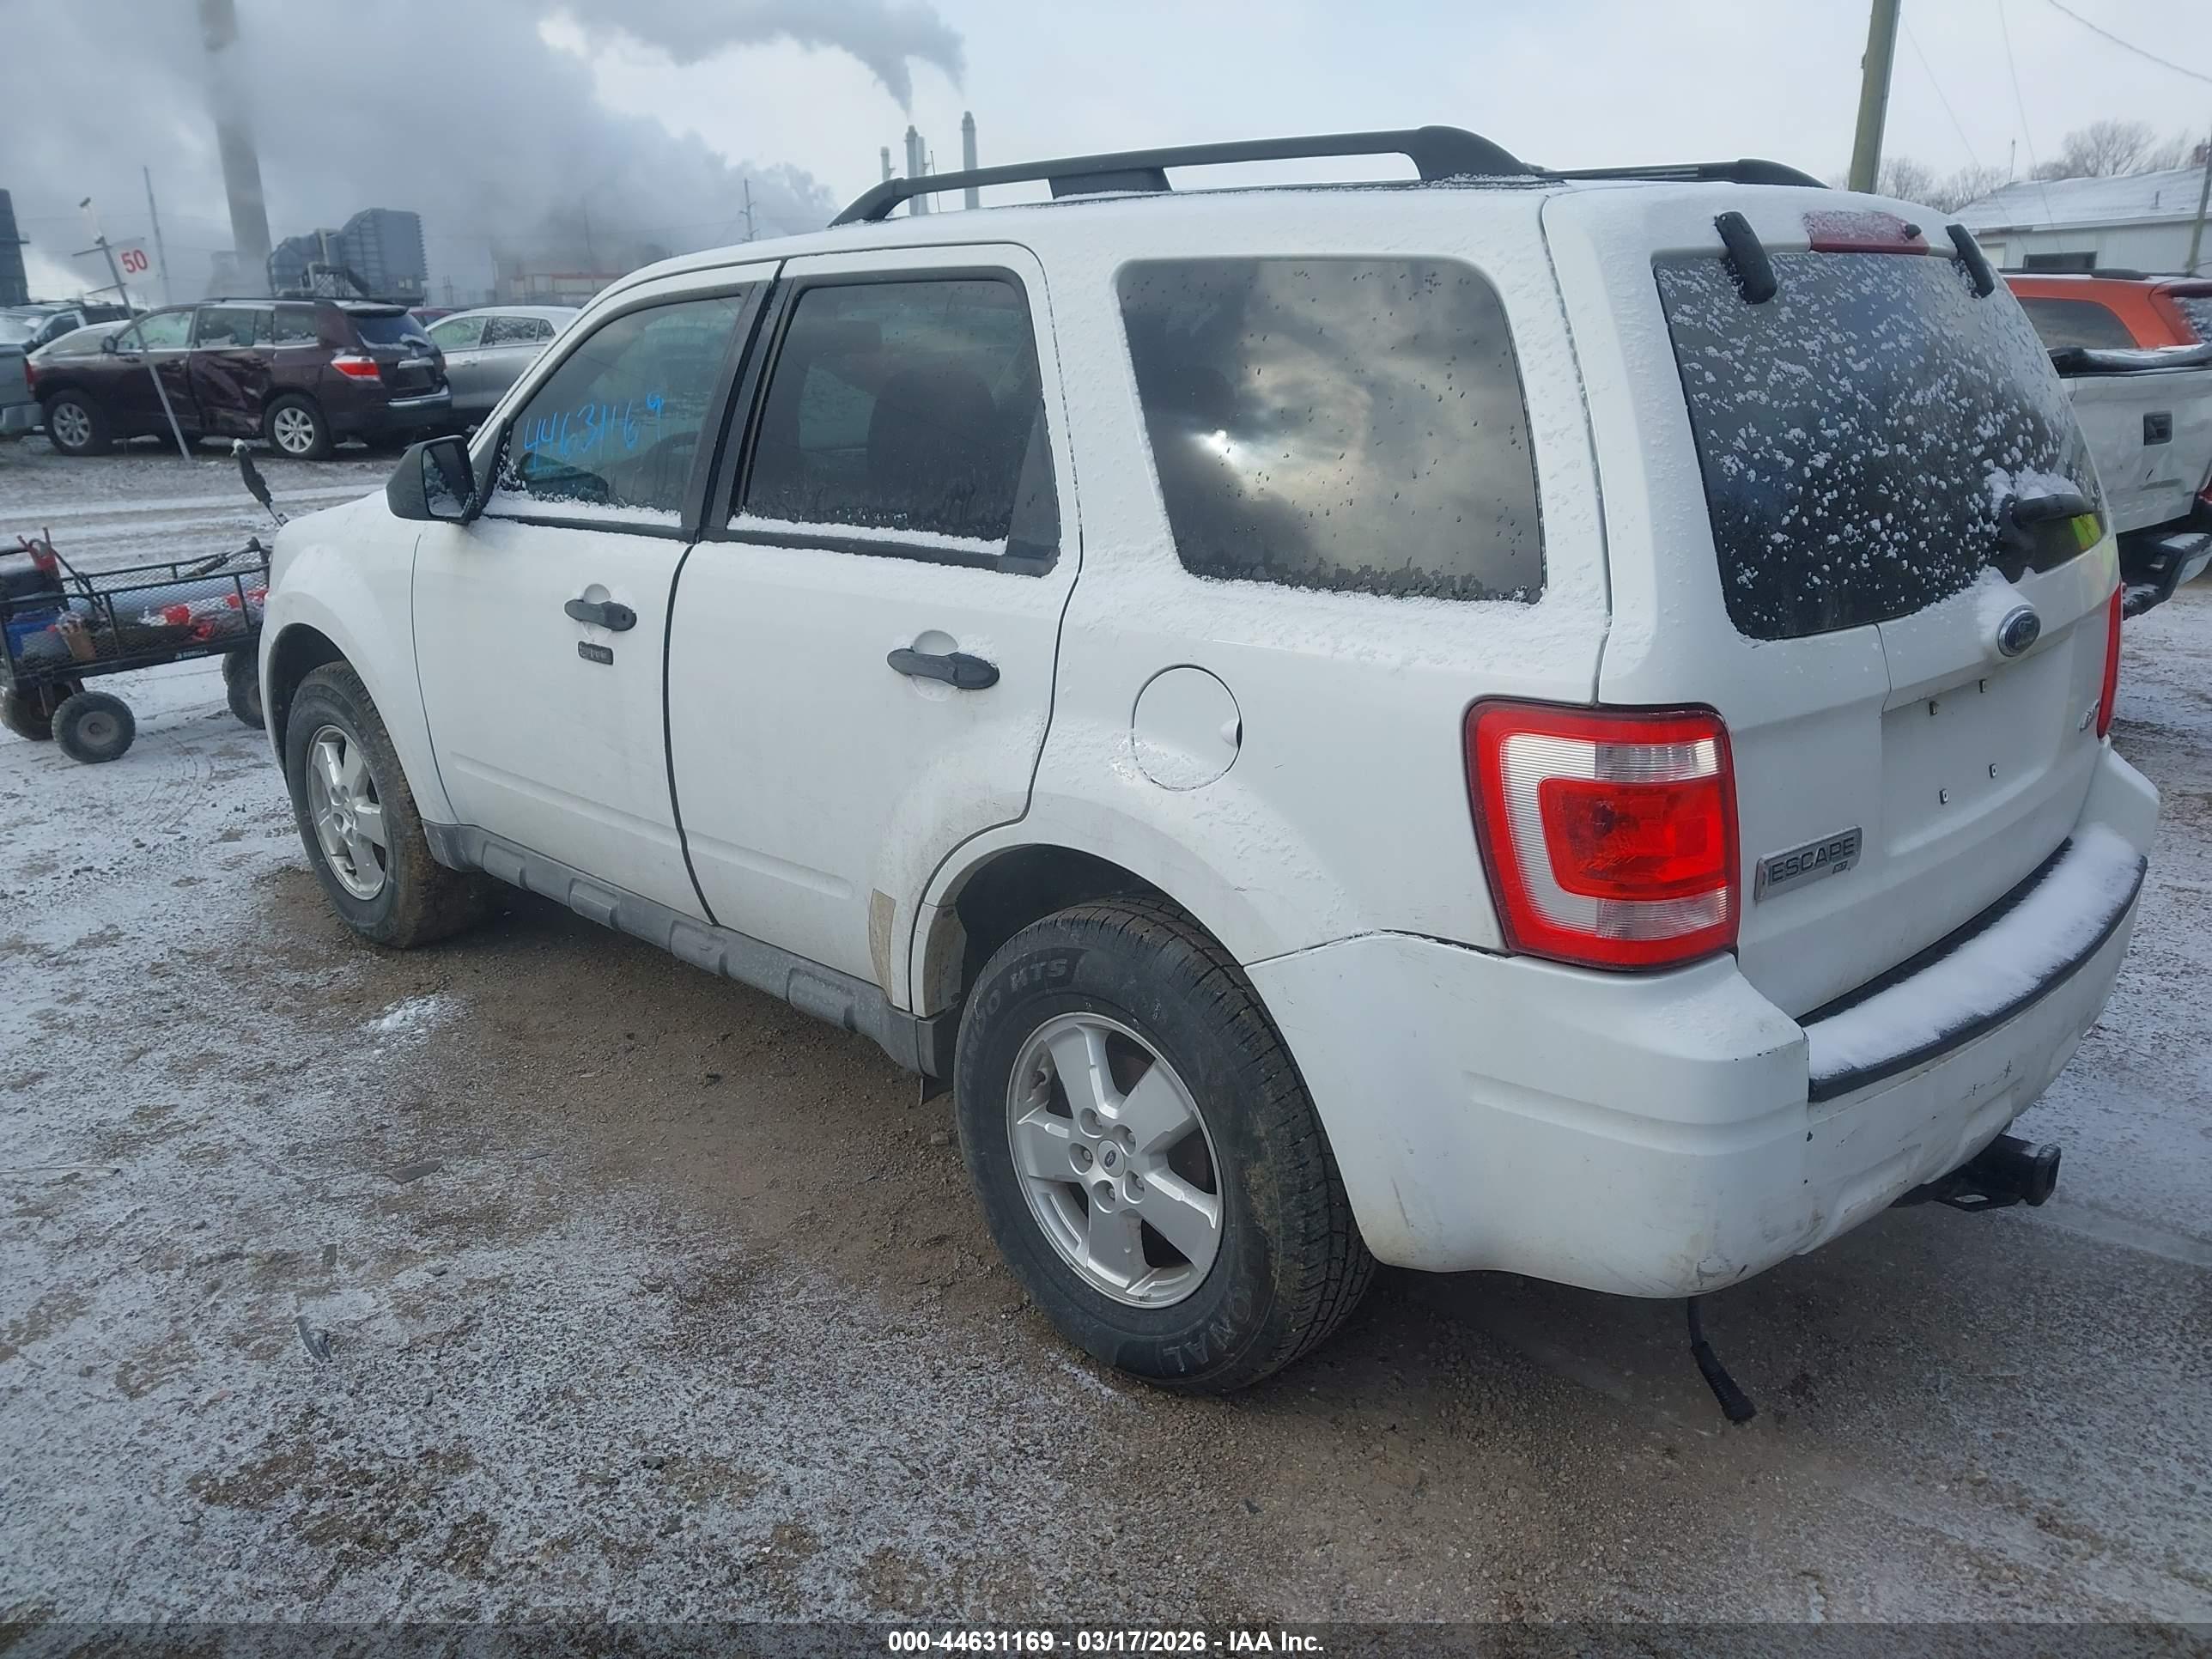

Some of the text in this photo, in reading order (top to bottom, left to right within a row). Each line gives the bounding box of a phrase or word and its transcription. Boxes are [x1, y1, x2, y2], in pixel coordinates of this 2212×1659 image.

[121, 249, 149, 274] 50
[523, 391, 665, 471] 44631169
[1771, 836, 1856, 884] ESCAPE
[1009, 957, 1068, 994] HTS
